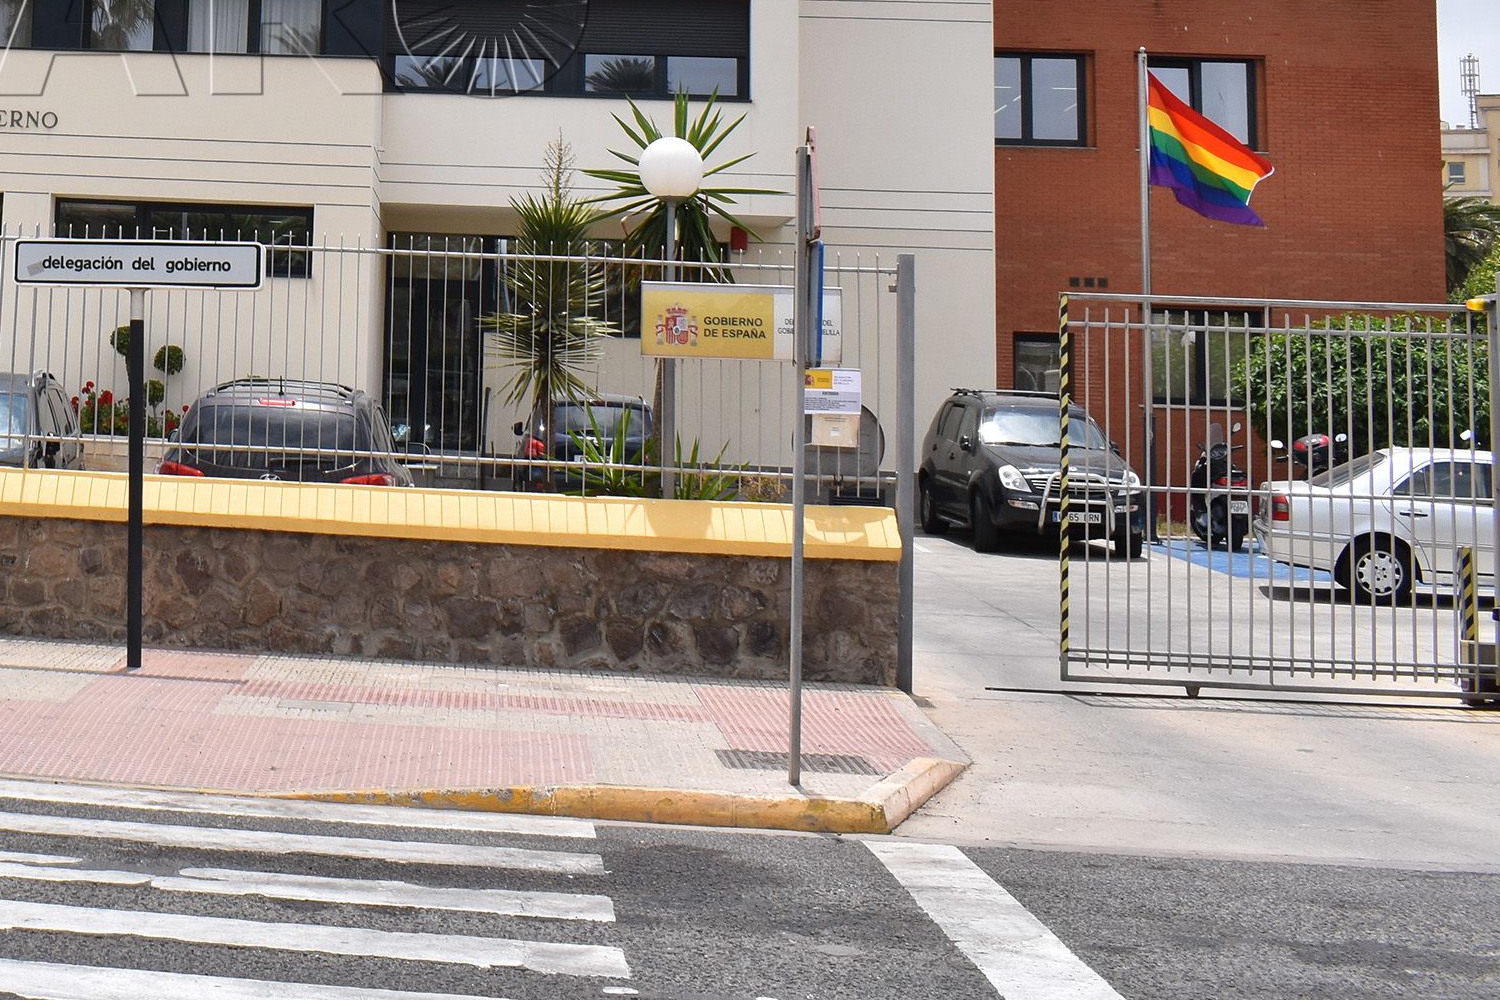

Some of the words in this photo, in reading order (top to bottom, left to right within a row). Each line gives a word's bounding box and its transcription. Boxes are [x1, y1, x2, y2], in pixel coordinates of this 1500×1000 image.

[42, 256, 123, 272] delegación
[132, 257, 155, 271] del
[165, 258, 232, 273] gobierno
[703, 316, 763, 327] GOBIERNO
[704, 328, 719, 338] DE
[722, 328, 766, 339] ESPAÑA
